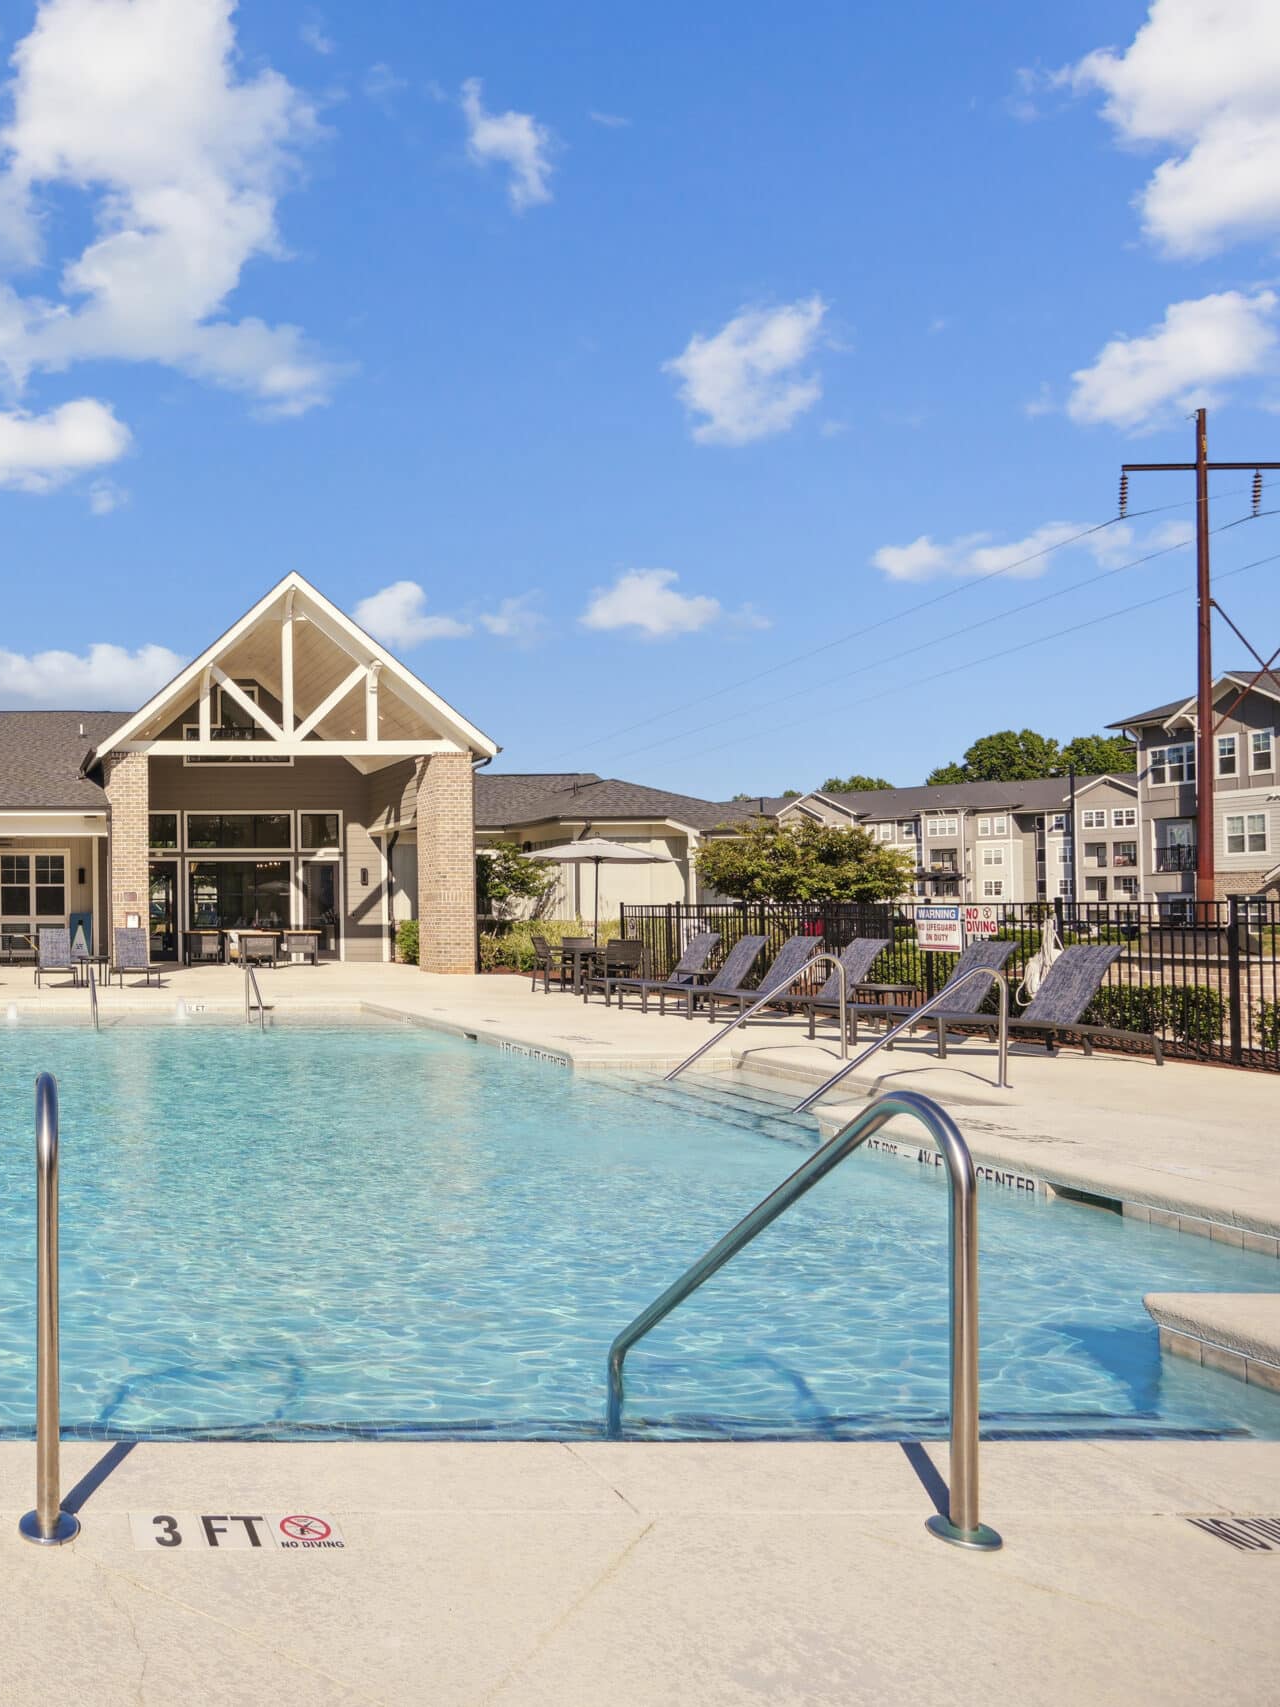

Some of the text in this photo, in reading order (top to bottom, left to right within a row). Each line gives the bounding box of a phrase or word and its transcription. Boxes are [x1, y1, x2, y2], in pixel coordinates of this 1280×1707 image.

[918, 909, 956, 919] WARNING
[966, 908, 978, 919] NO
[927, 923, 956, 931] LIFEGUARD
[966, 921, 996, 932] DIVING
[926, 933, 948, 941] ON DUTY
[152, 1515, 264, 1547] 3 FT
